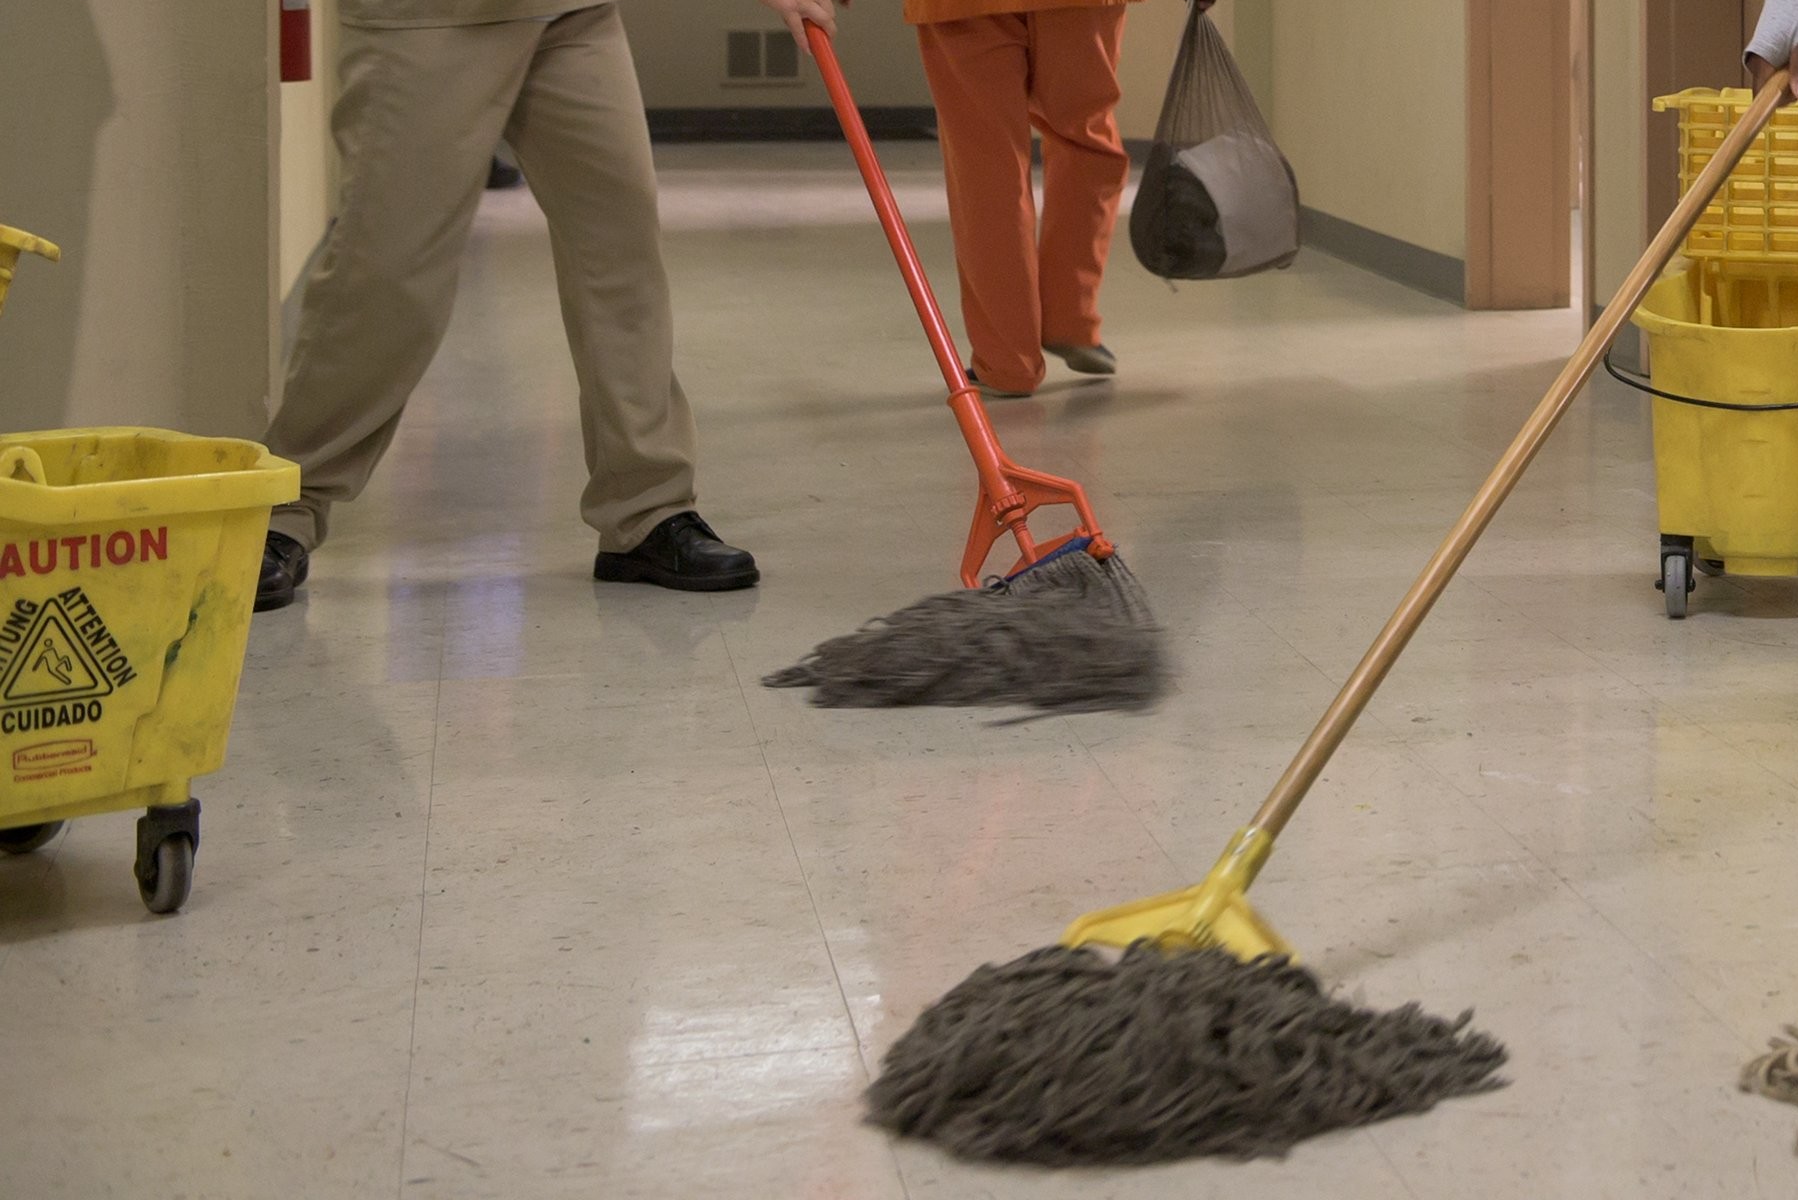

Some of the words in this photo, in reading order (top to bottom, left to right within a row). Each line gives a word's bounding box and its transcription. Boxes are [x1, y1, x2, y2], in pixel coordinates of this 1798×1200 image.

[0, 526, 168, 580] AUTION
[58, 586, 138, 688] ATTENTION
[1, 699, 102, 734] CUIDADO
